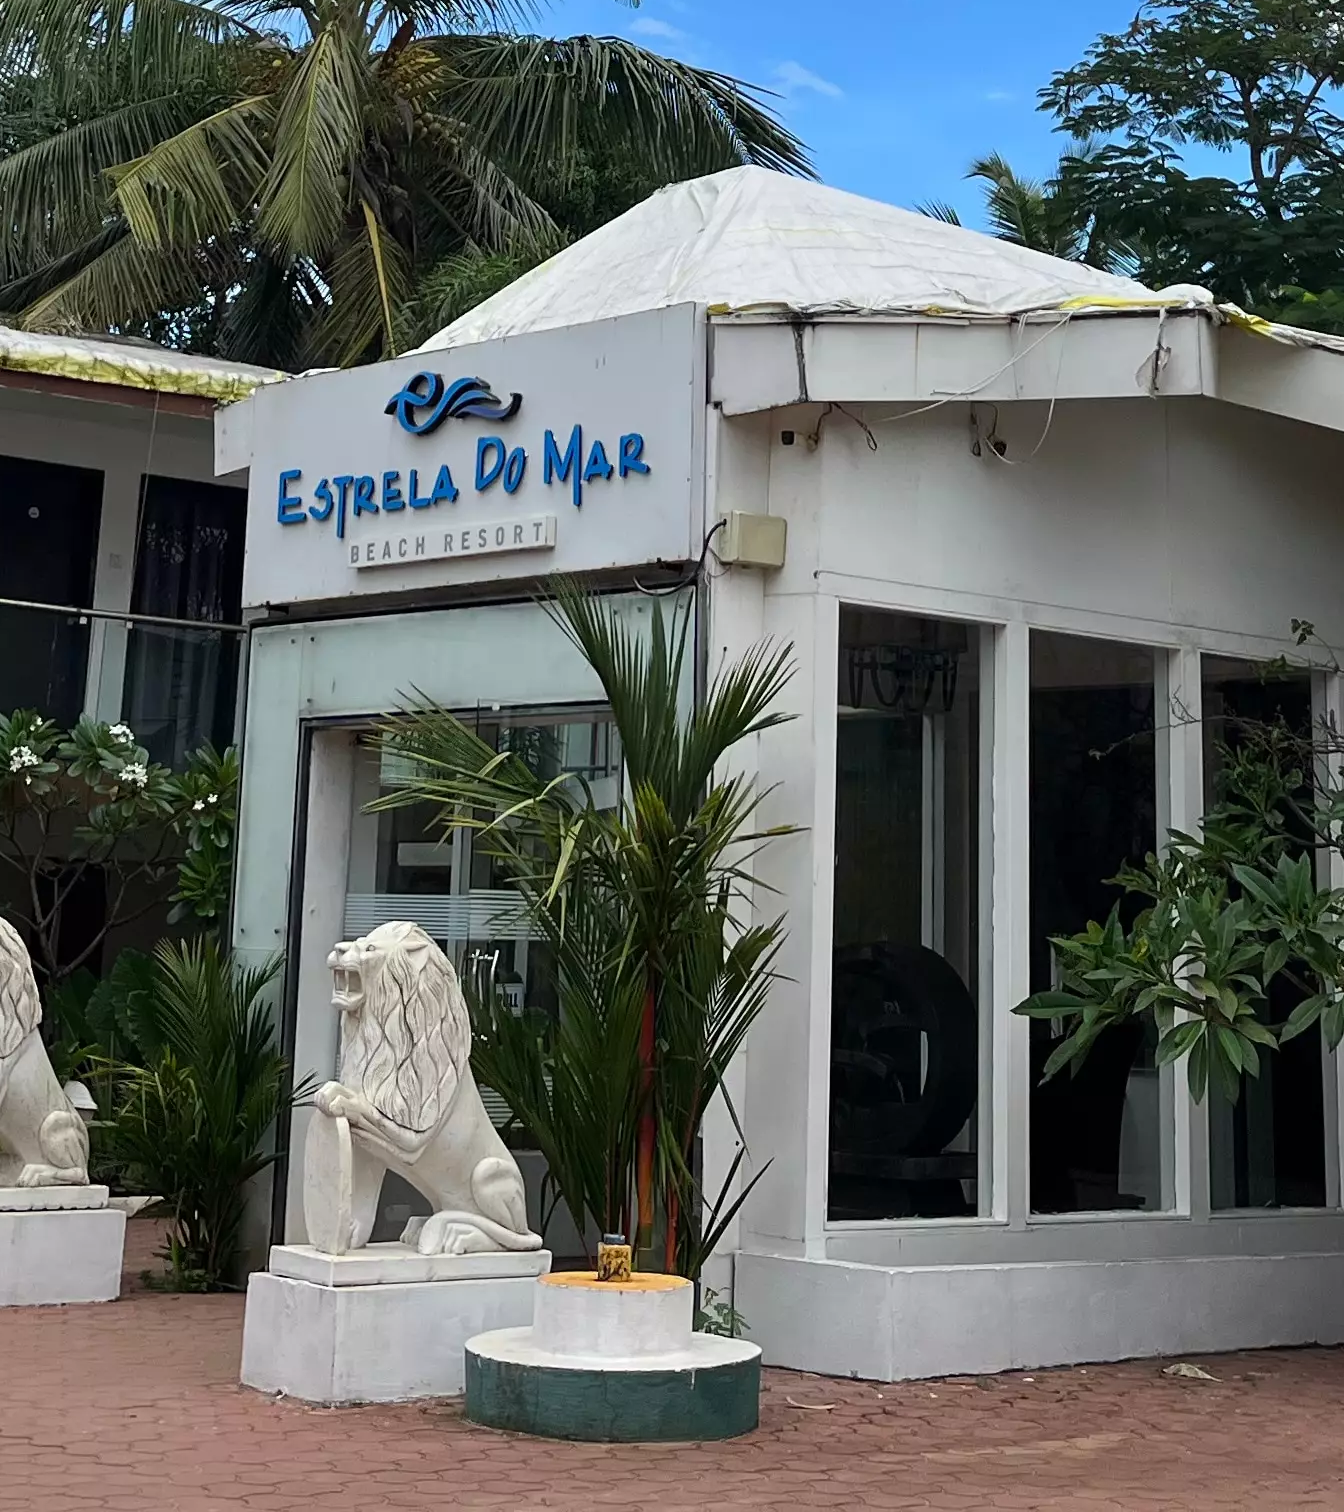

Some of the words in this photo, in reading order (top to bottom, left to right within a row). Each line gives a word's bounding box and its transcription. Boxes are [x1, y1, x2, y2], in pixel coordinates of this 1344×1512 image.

[277, 464, 459, 539] ESTRELA
[543, 424, 651, 507] MAR
[350, 536, 425, 564] BEACH
[444, 522, 543, 553] RESORT
